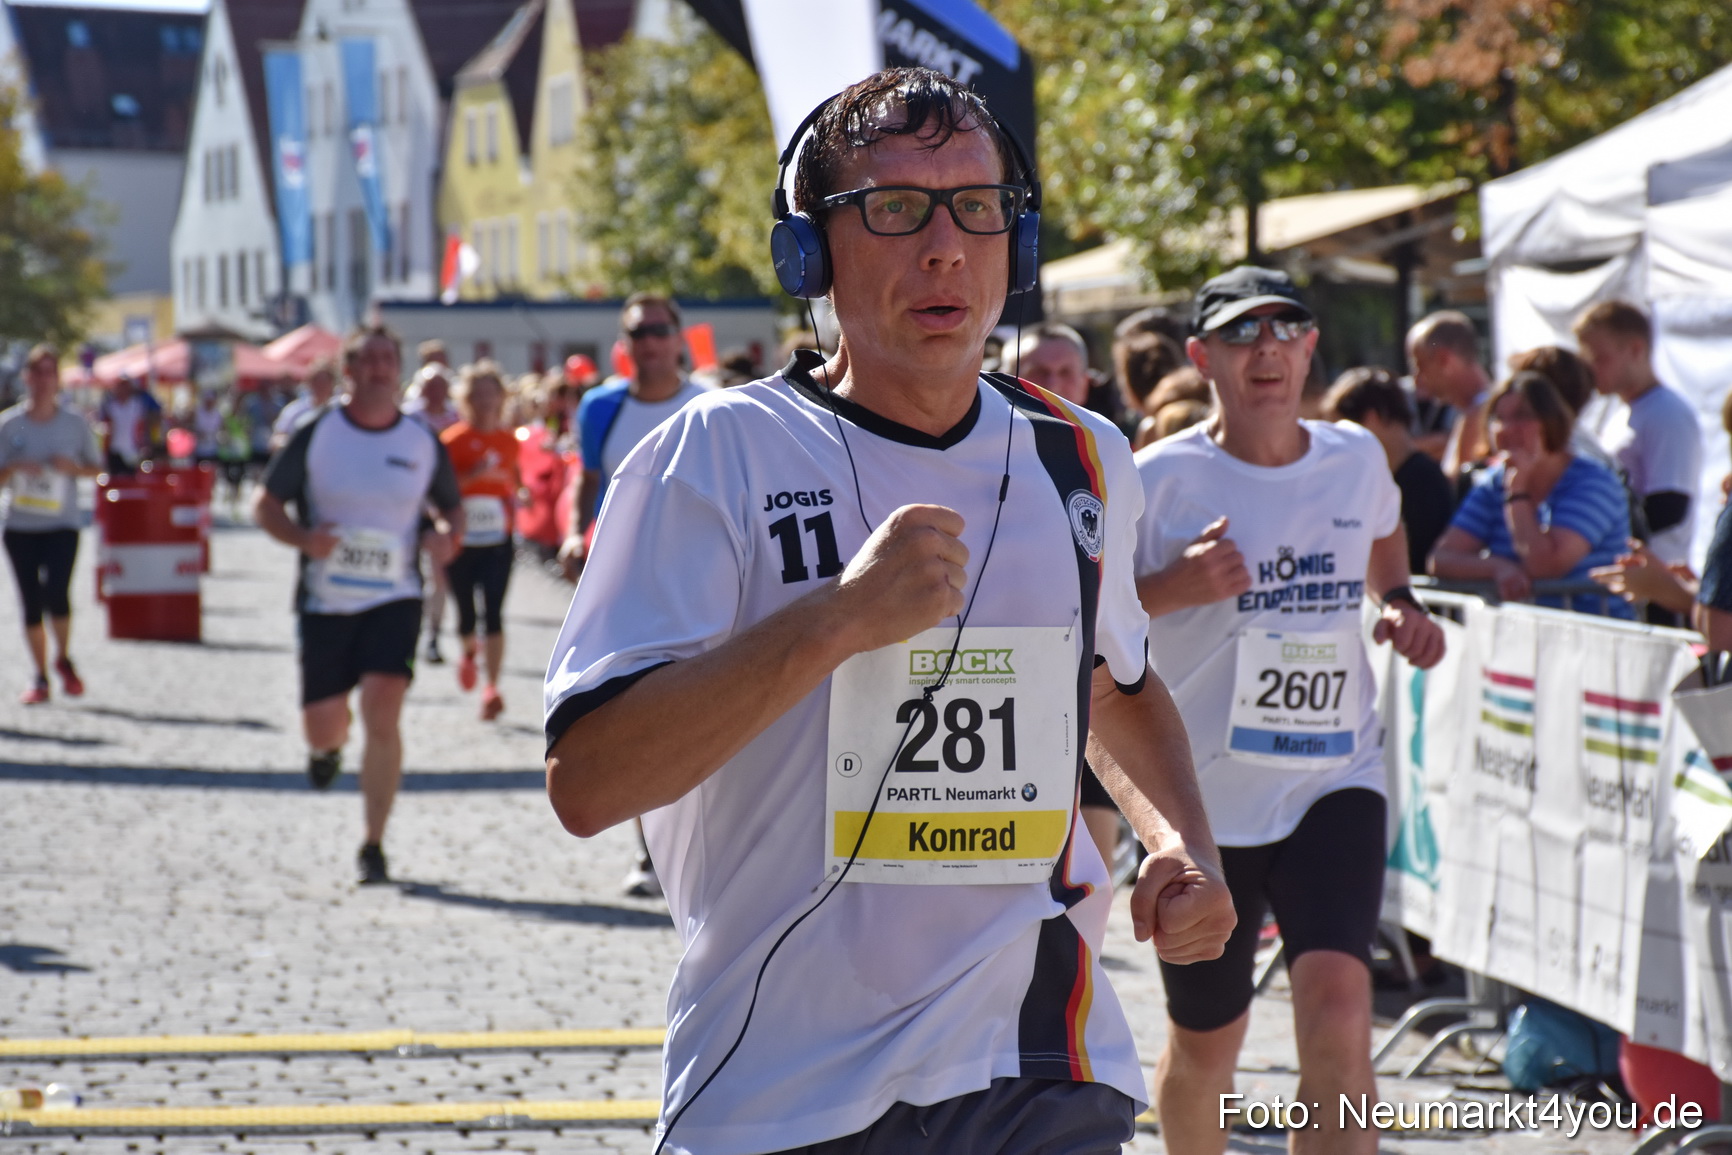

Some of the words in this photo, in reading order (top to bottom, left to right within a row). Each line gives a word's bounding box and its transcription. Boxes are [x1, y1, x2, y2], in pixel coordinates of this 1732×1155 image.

[763, 489, 834, 512] JOGIS
[1333, 518, 1361, 528] Martin
[768, 510, 844, 584] 11
[909, 649, 1015, 675] BOCK
[909, 677, 941, 686] inspire
[955, 677, 979, 685] smart
[981, 676, 1016, 685] concepts
[1255, 668, 1348, 711] 2607
[895, 697, 1016, 773] 281
[1272, 735, 1326, 754] Martin
[887, 787, 942, 801] PARTL
[945, 786, 1016, 800] Neumarkt
[908, 821, 1016, 852] Konrad
